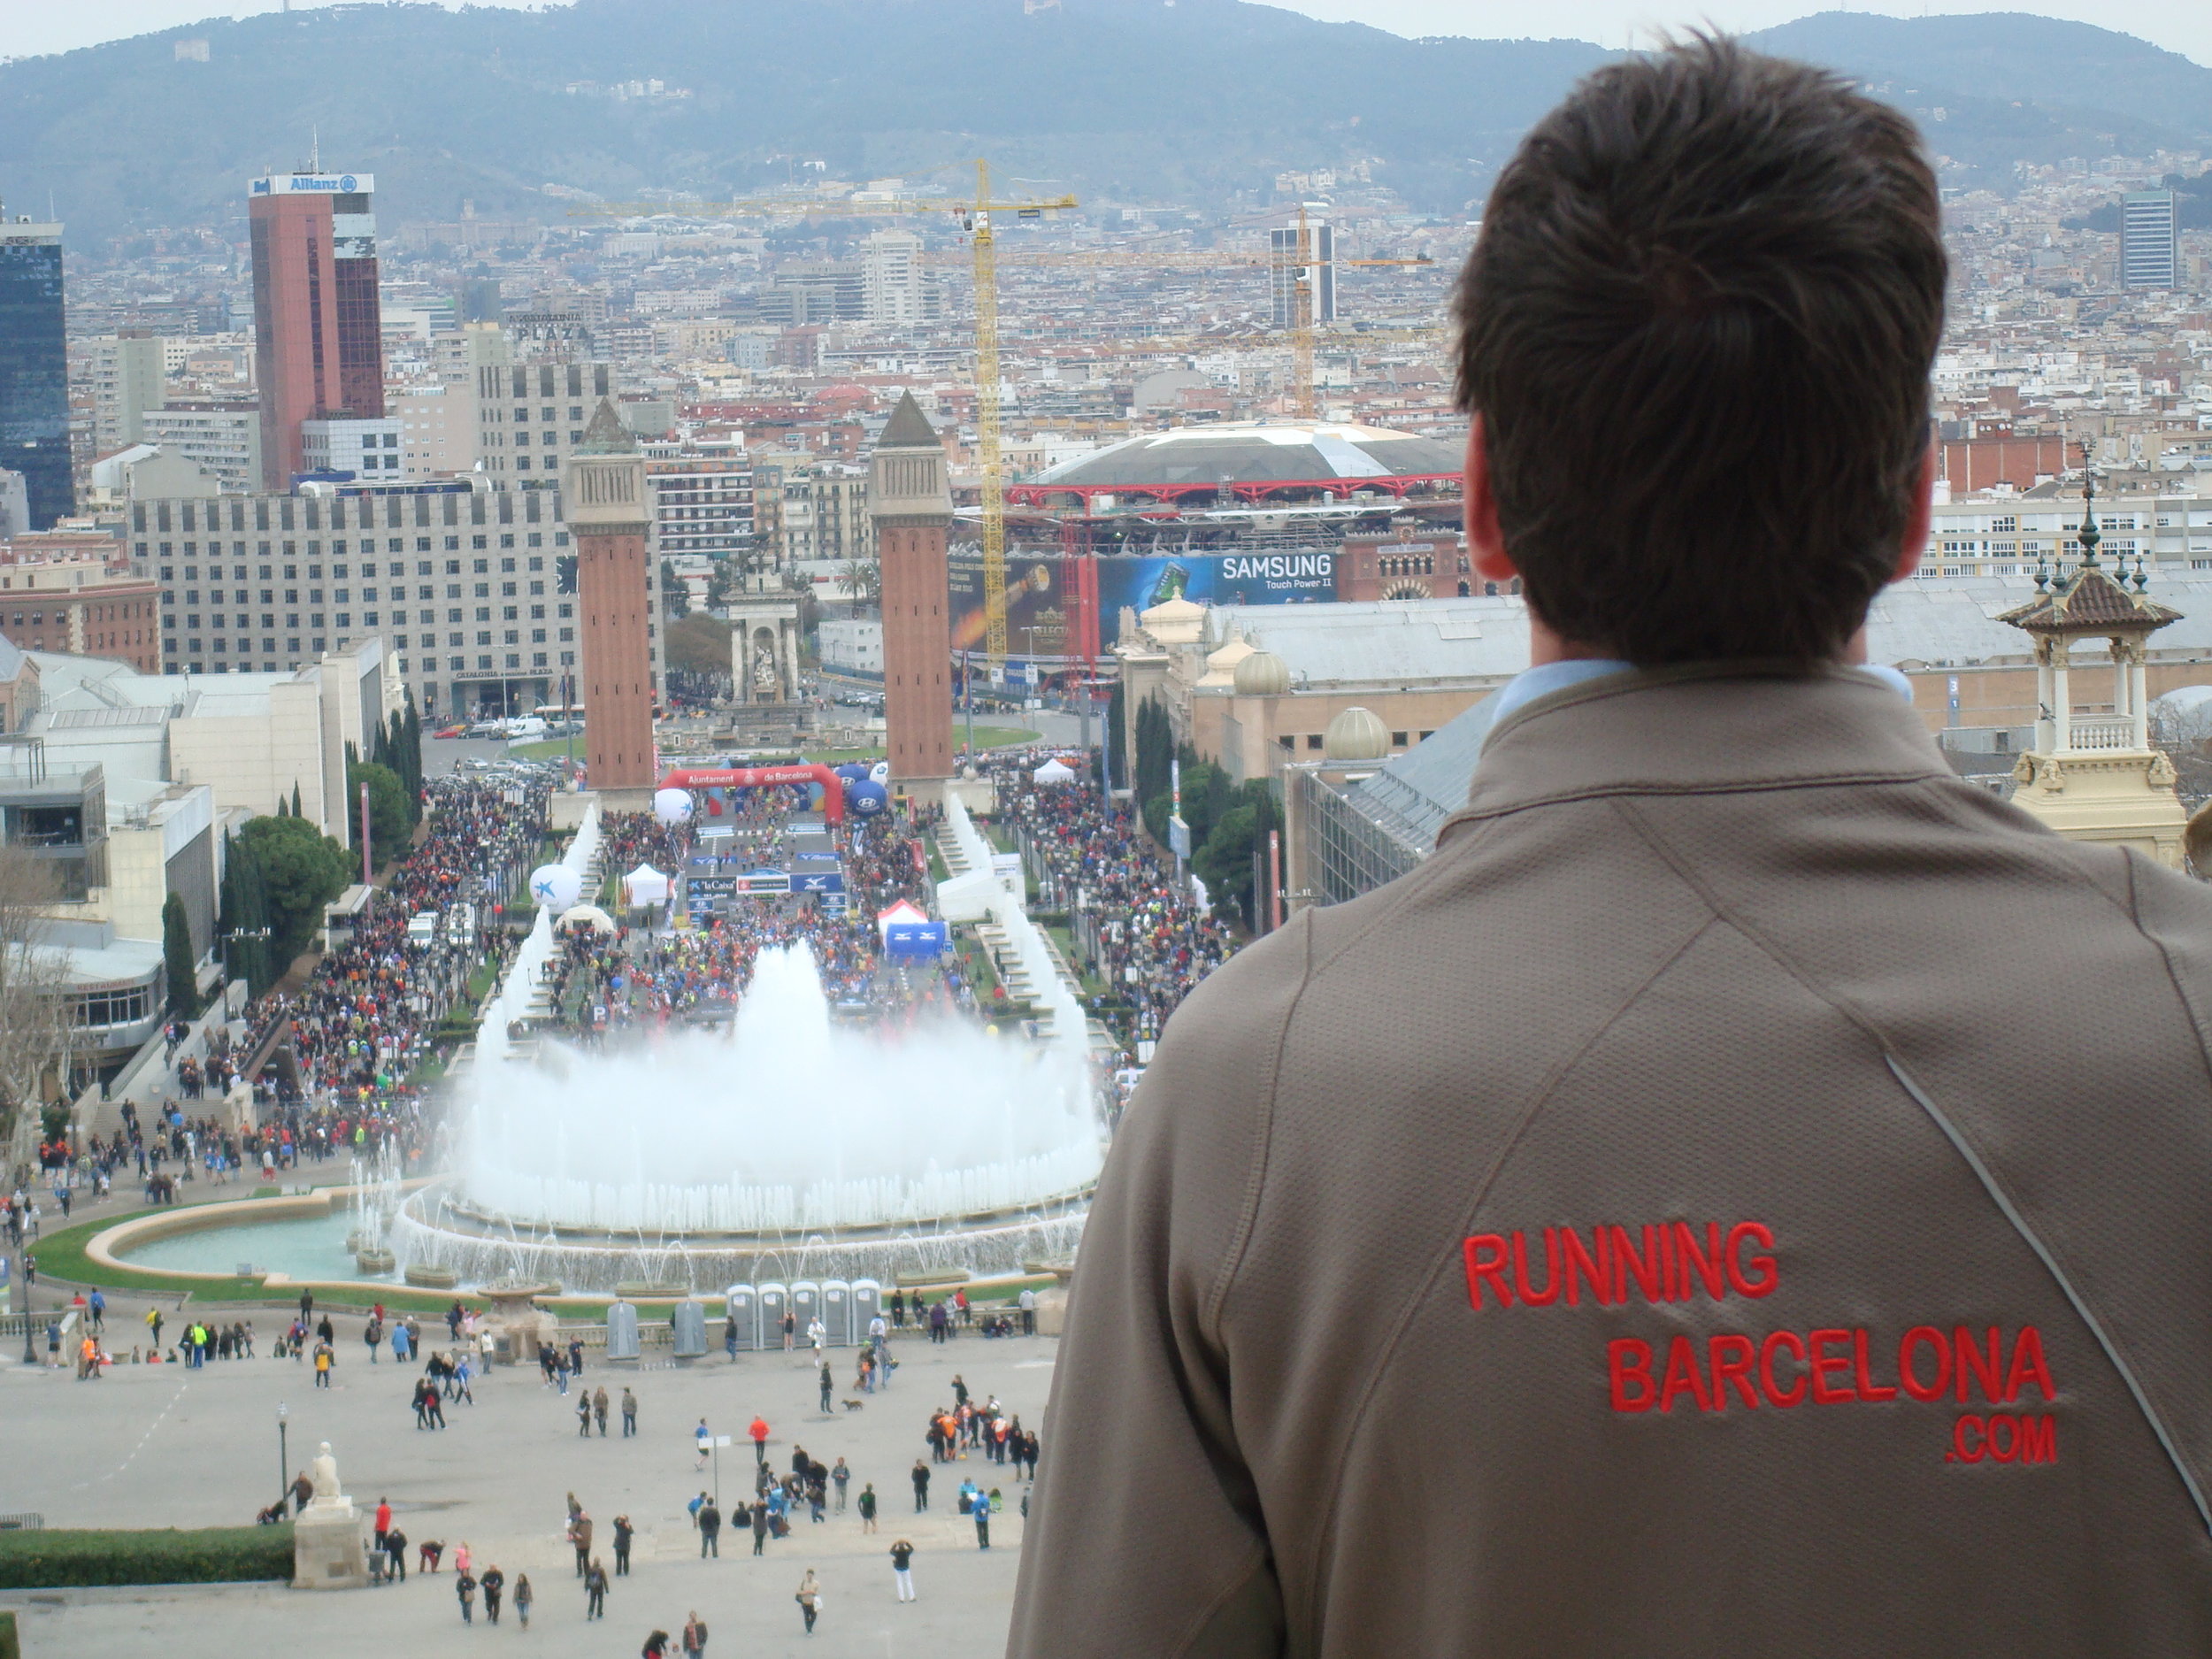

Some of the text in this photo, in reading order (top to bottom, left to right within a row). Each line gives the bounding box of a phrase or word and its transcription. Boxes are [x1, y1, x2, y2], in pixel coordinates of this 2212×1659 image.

[291, 178, 338, 190] Allianz
[518, 327, 588, 341] PLAZA
[1223, 554, 1332, 580] SAMSUNG
[1265, 578, 1332, 589] Touch Power II
[1950, 680, 1957, 692] 3
[688, 775, 733, 785] Ajuntament
[775, 772, 812, 781] Barcelona
[1271, 839, 1278, 849] 5
[594, 1006, 605, 1021] P
[1463, 1221, 1778, 1310] RUNNING
[1609, 1326, 2055, 1413] BARCELONA
[1946, 1414, 2056, 1464] .COM
